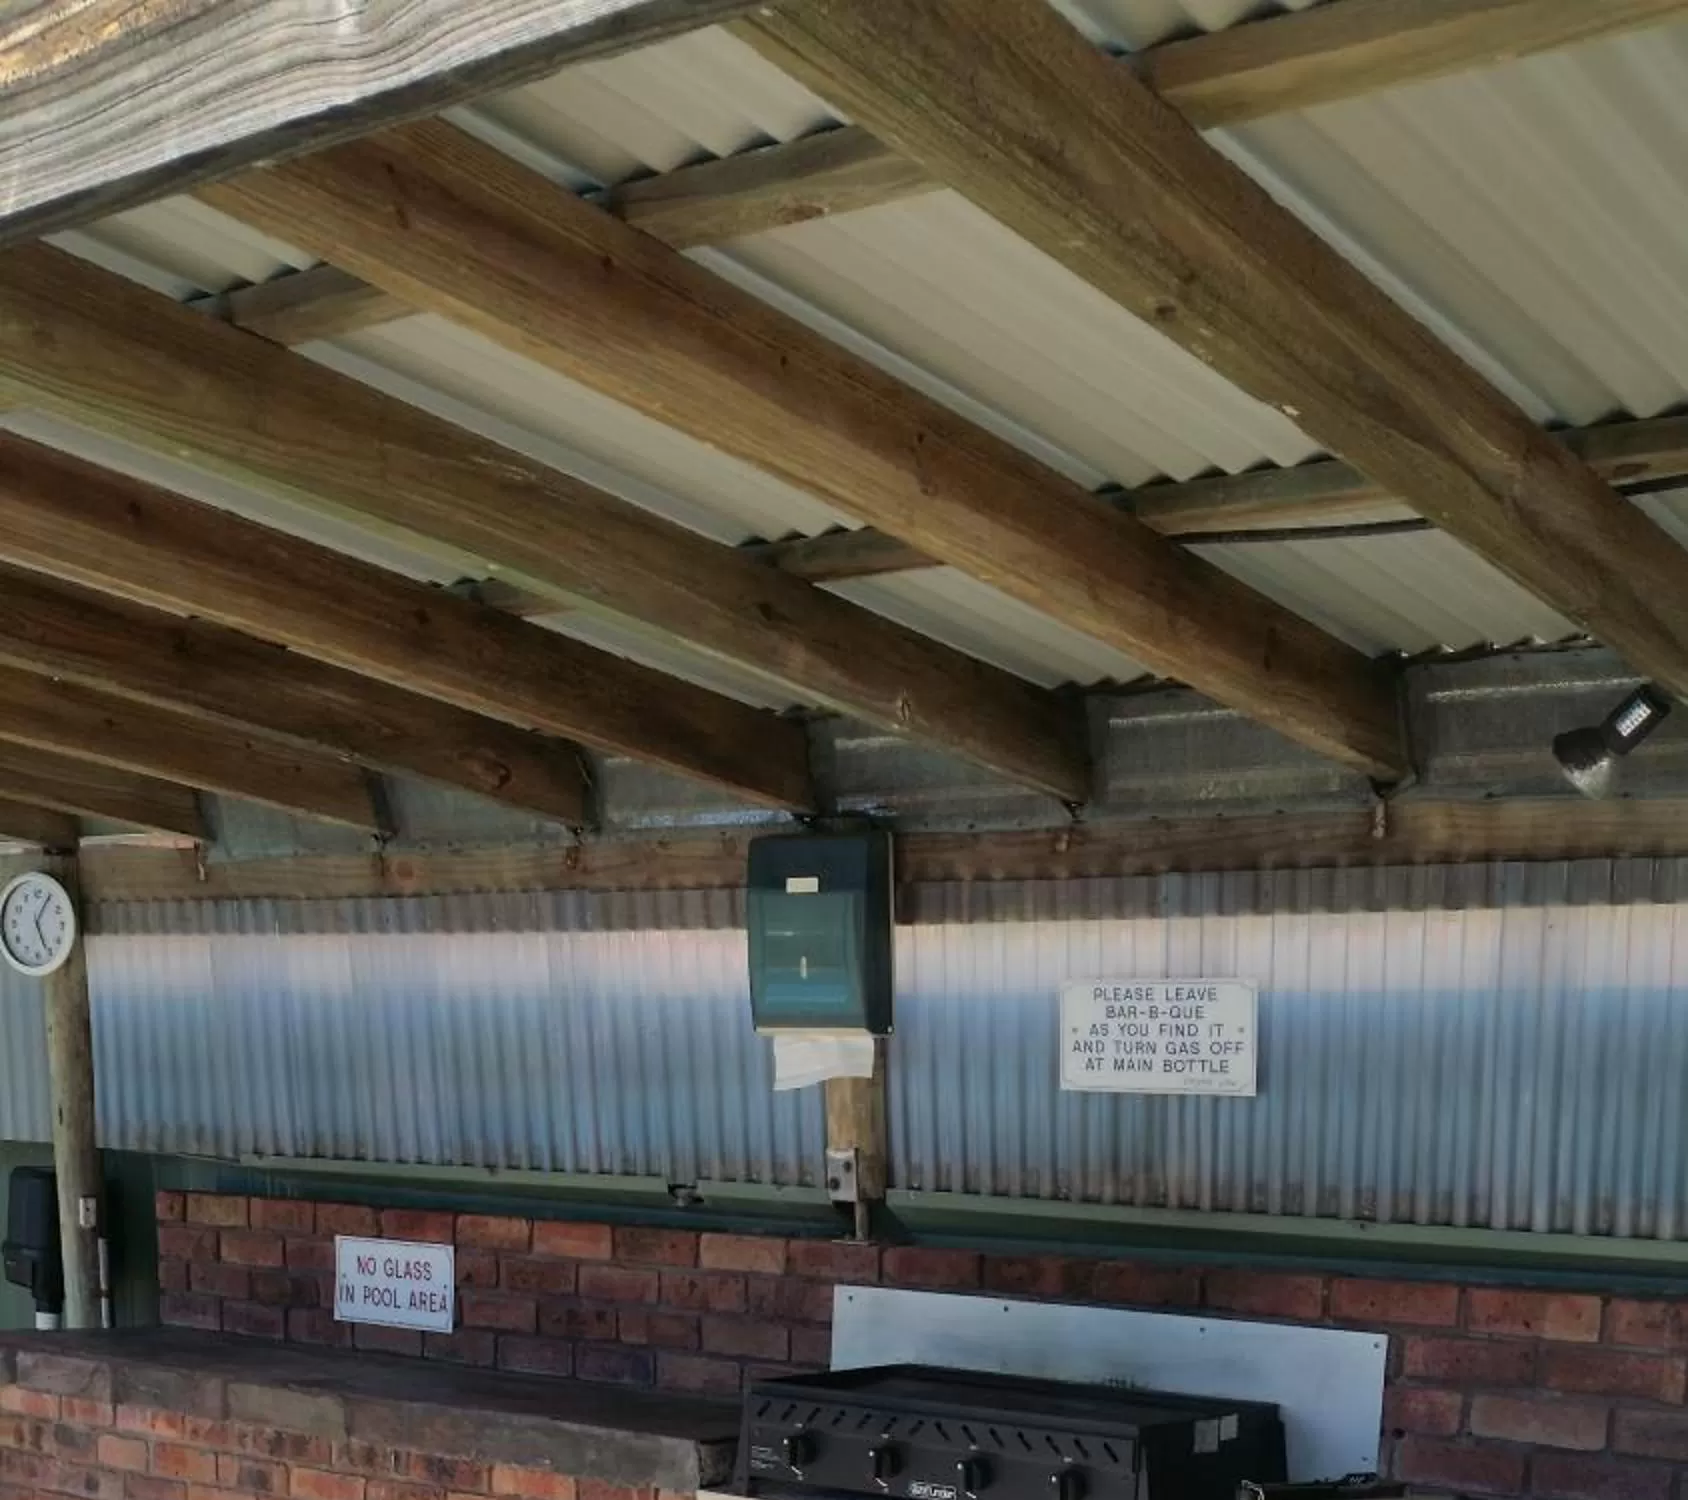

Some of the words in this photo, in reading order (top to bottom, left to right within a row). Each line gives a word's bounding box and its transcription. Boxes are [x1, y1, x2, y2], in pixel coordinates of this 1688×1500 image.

[1092, 987, 1153, 1001] PLEASE
[1165, 987, 1218, 1001] LEAVE
[1105, 1005, 1206, 1019] BAR-B-QUE
[1089, 1023, 1109, 1037] AS
[1118, 1023, 1149, 1037] YOU
[1159, 1023, 1199, 1037] FIND
[1208, 1023, 1224, 1037] IT
[1072, 1039, 1105, 1053] AND
[1114, 1040, 1157, 1054] TURN
[1165, 1041, 1201, 1055] GAS
[1209, 1041, 1245, 1055] OFF
[1085, 1058, 1105, 1071] AT
[1113, 1059, 1153, 1072] MAIN
[1163, 1059, 1229, 1073] BOTTLE
[357, 1255, 377, 1276] NO
[383, 1257, 433, 1281] GLASS
[339, 1283, 355, 1304] IN
[363, 1285, 401, 1309] POOL
[408, 1289, 448, 1313] AREA
